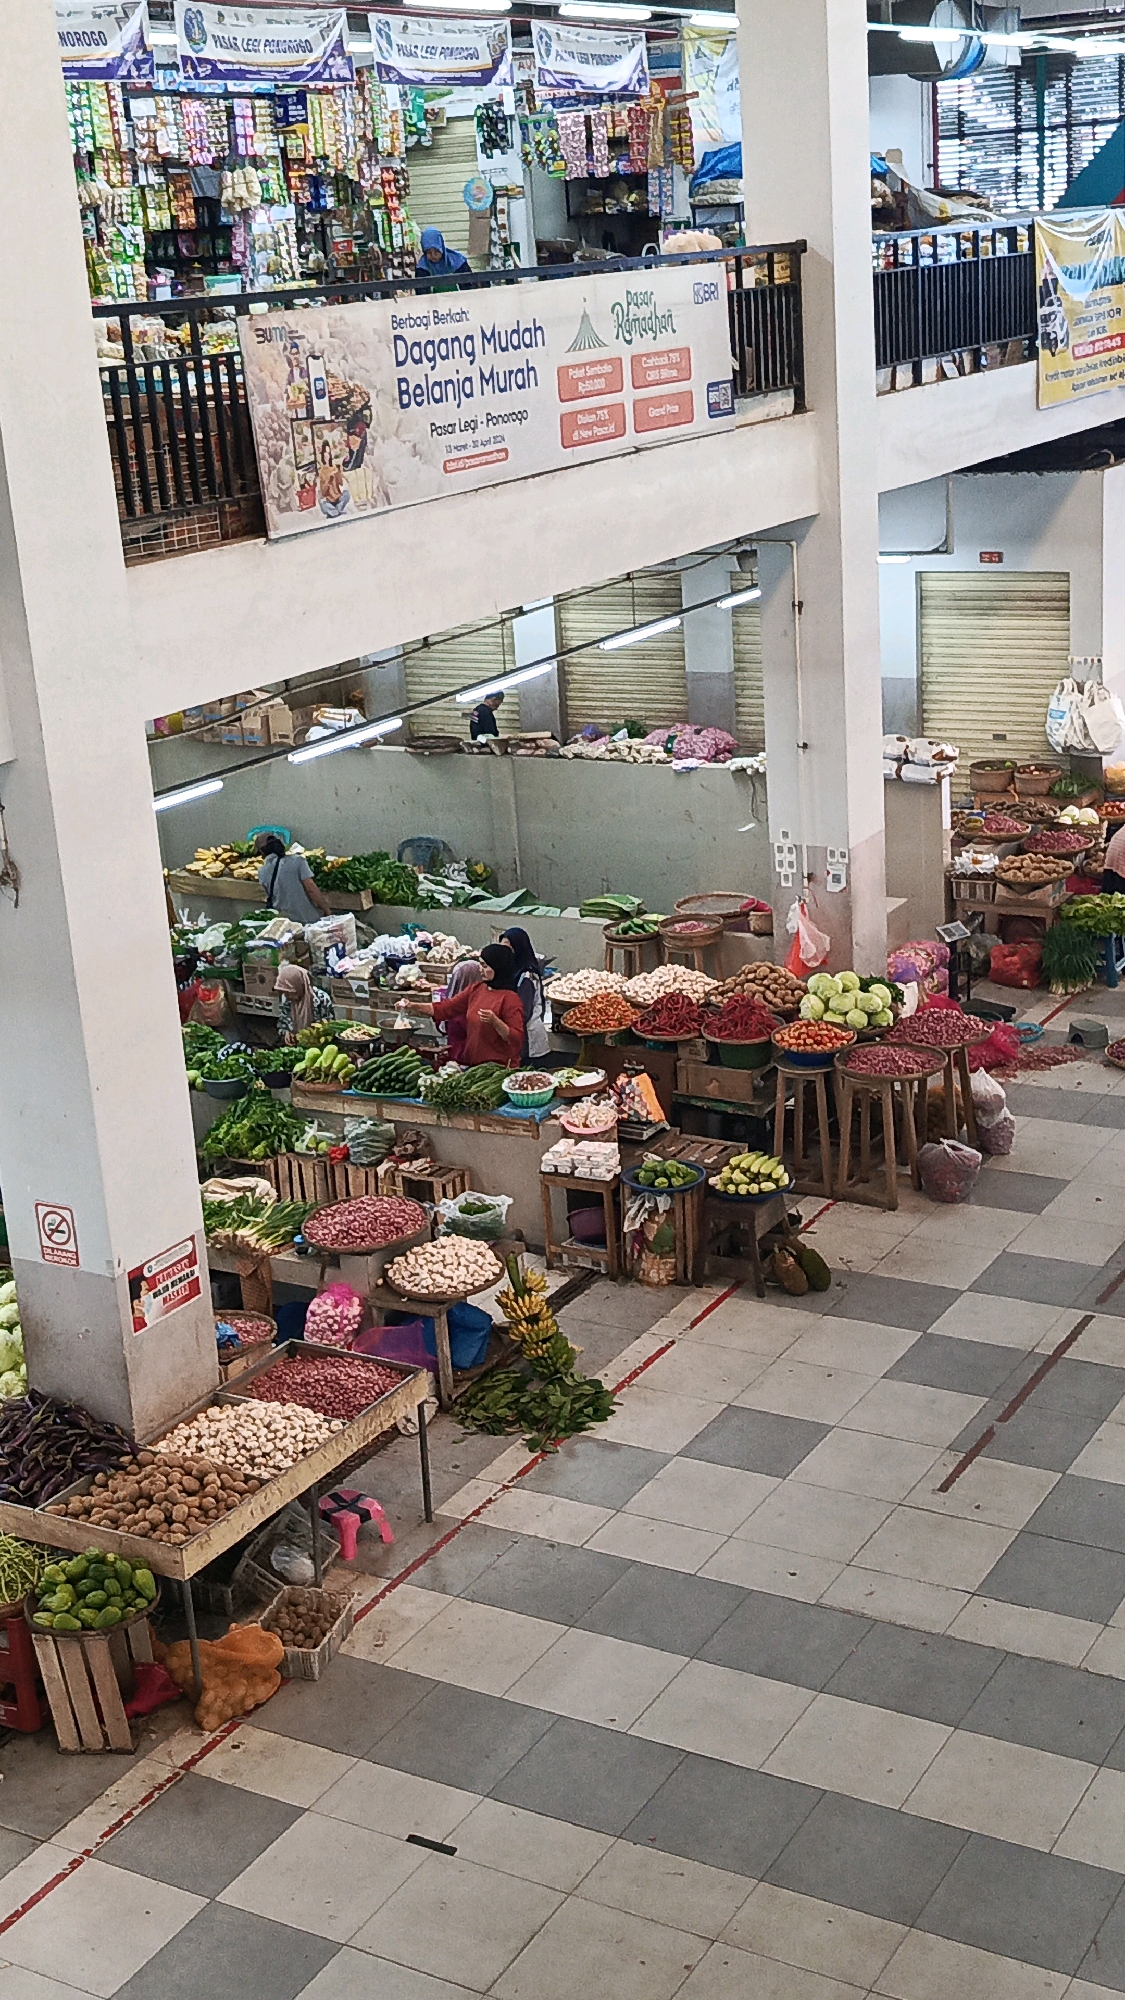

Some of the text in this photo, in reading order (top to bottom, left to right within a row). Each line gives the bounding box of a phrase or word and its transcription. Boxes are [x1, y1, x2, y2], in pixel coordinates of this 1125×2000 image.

[391, 307, 470, 330] Berbagi Berkah:
[611, 301, 676, 345] Ramadhan
[393, 318, 545, 371] Dagang Mudah
[397, 359, 539, 409] Belanja Murah
[430, 421, 457, 438] Pasar
[458, 414, 478, 434] Legi
[485, 409, 529, 428] Ponorogo
[163, 1282, 190, 1305] MASKER
